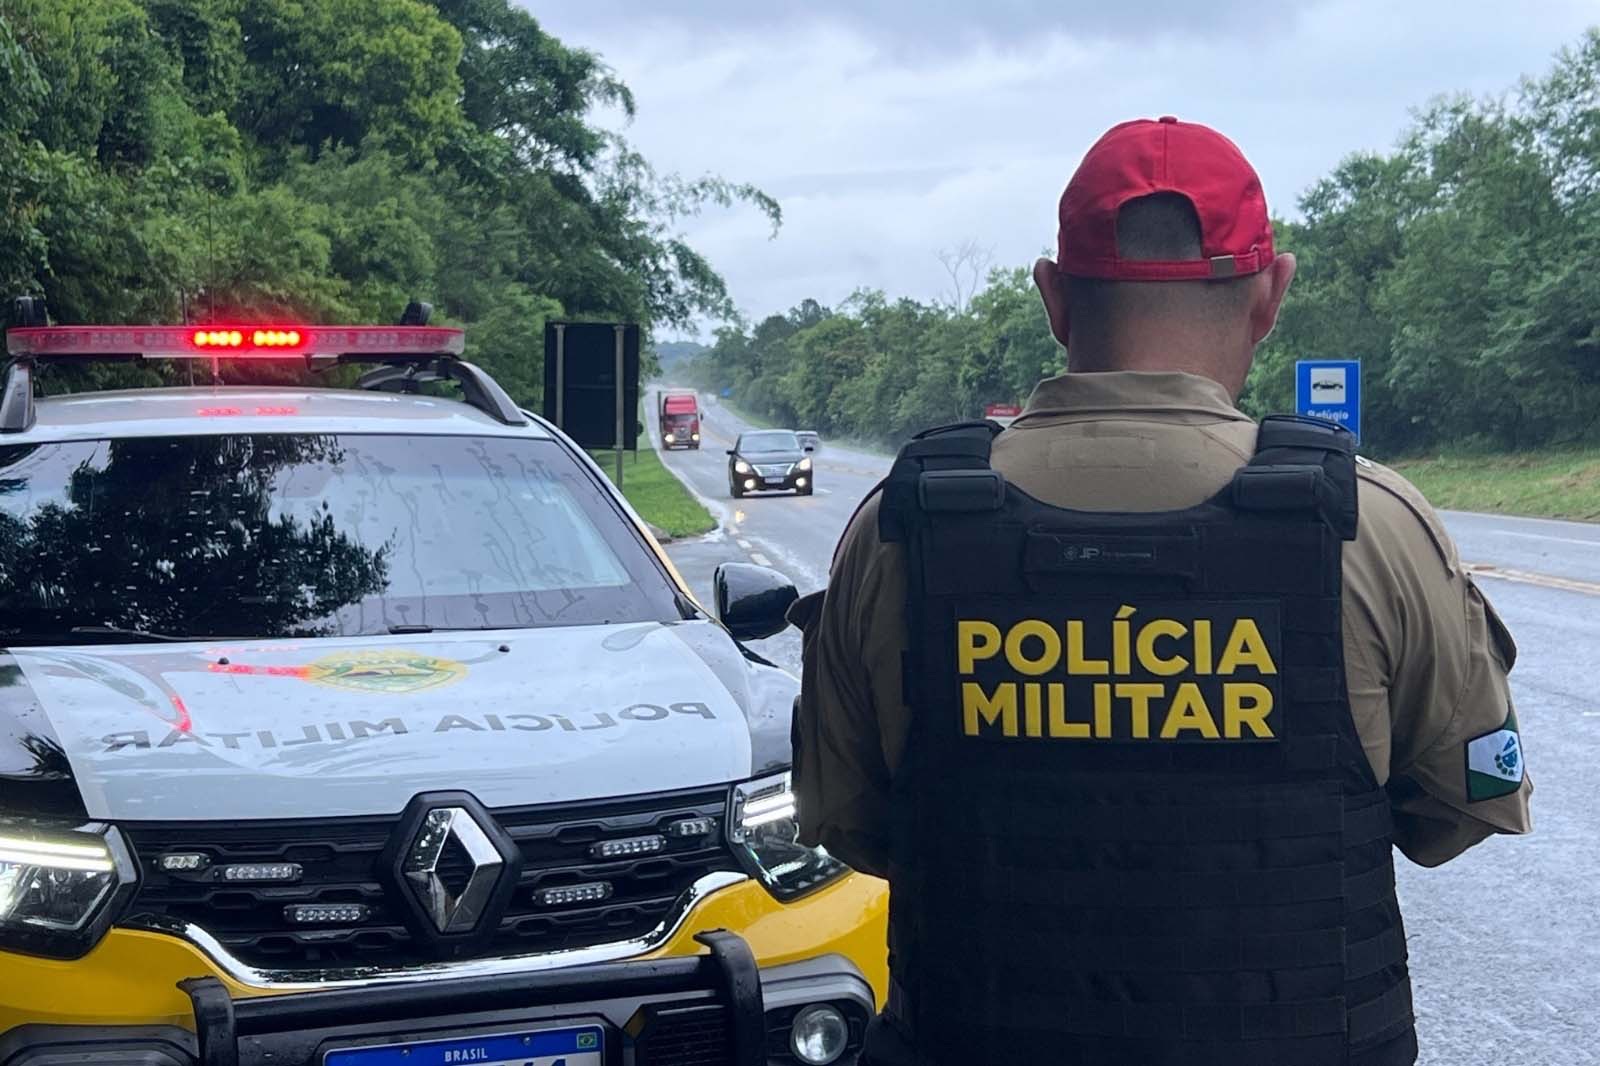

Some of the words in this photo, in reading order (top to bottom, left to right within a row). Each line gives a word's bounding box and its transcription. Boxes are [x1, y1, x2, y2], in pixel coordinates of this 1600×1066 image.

[957, 604, 1278, 676] POLÍCIA
[961, 682, 1276, 739] MILITAR
[444, 1047, 489, 1063] BRASIL
